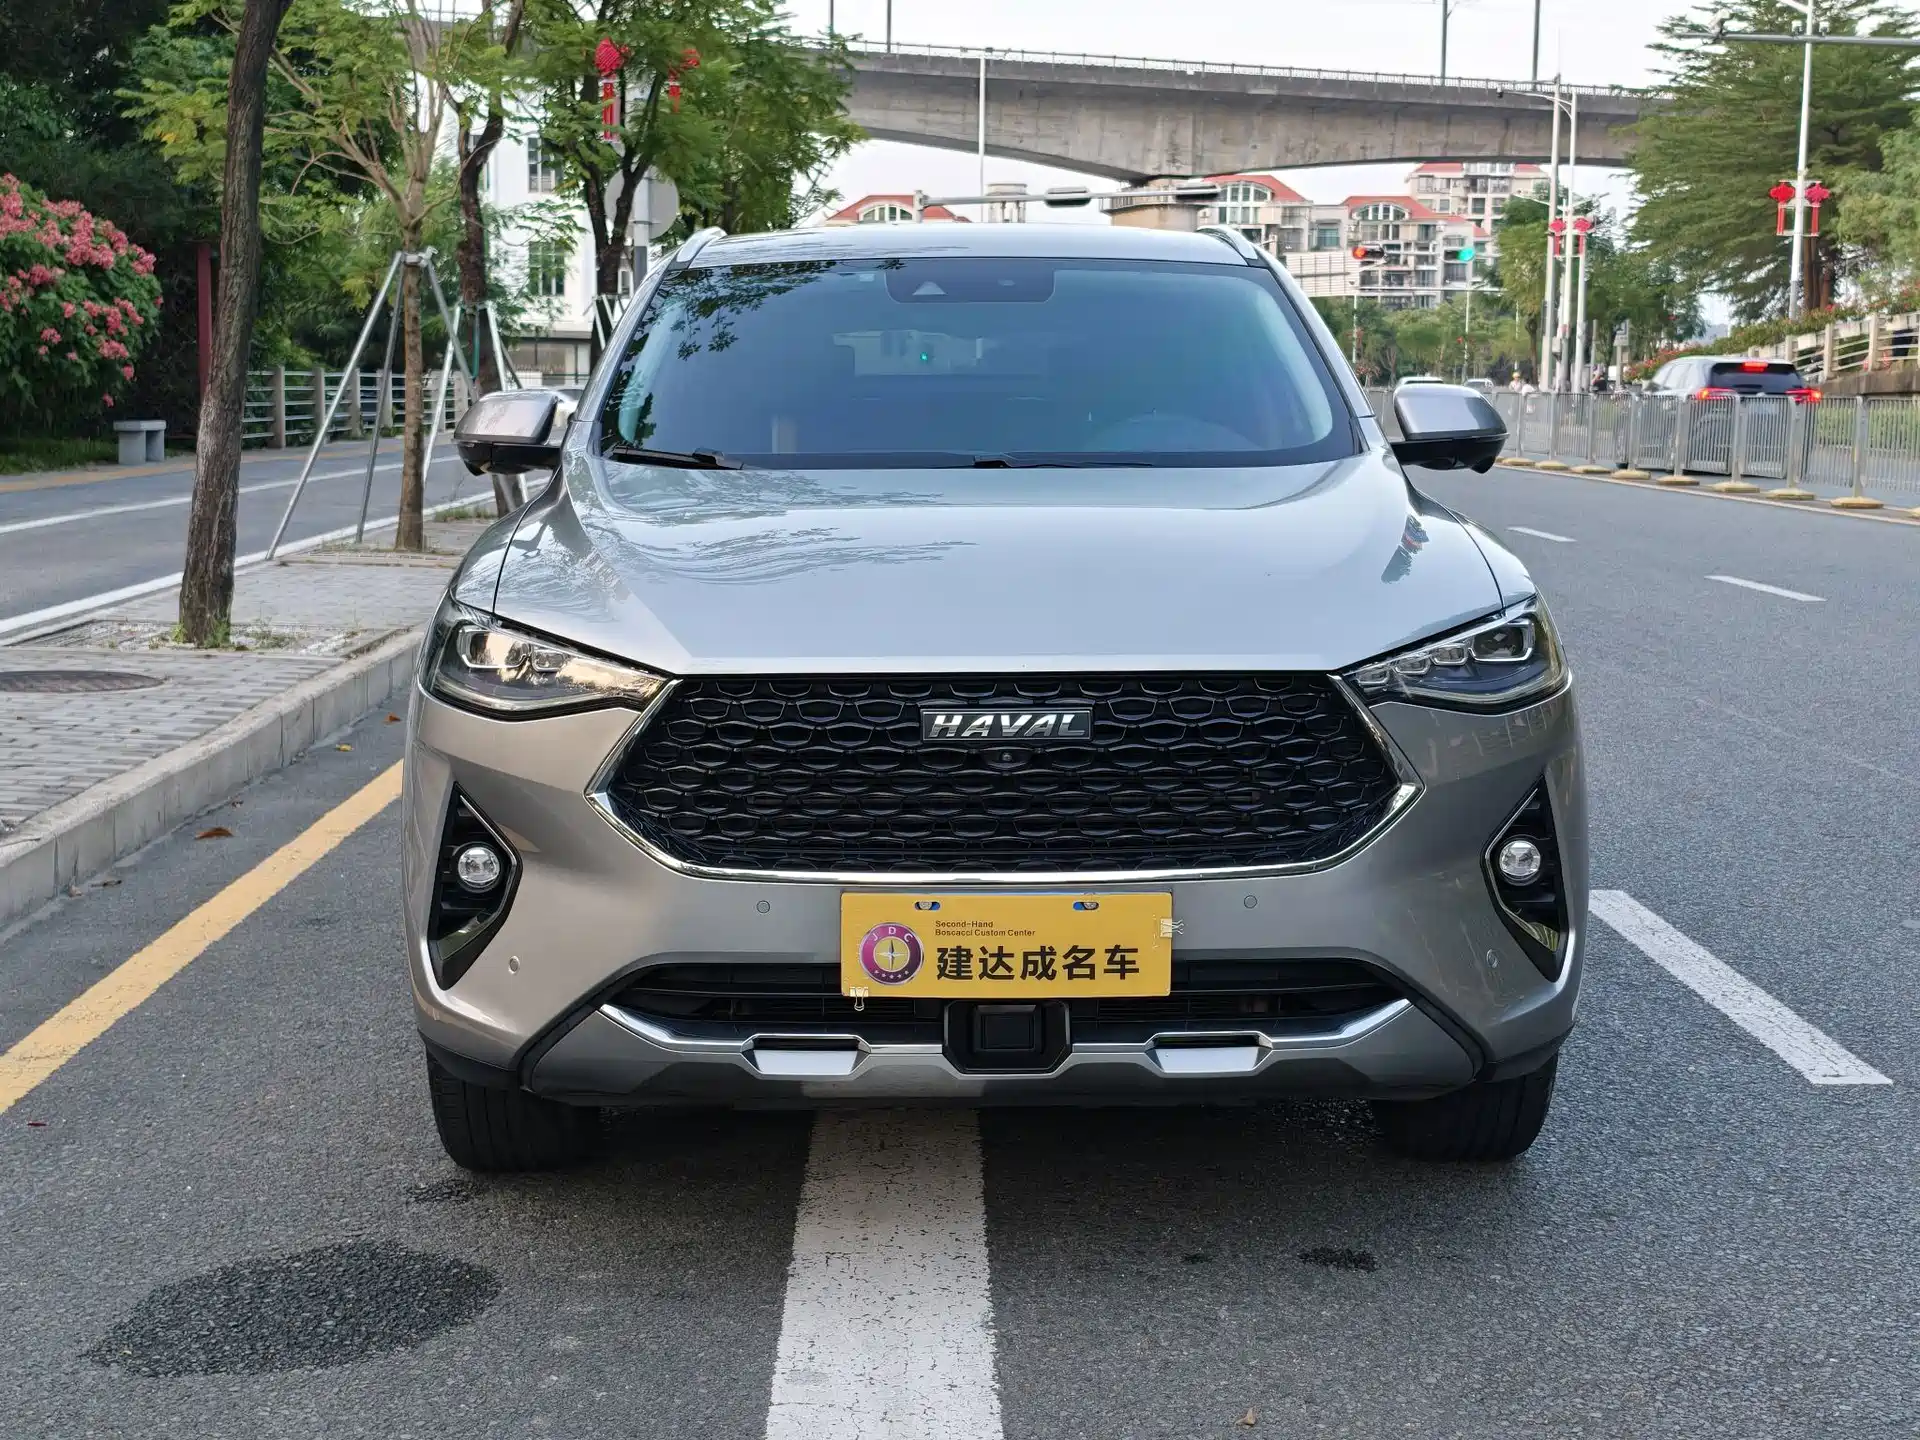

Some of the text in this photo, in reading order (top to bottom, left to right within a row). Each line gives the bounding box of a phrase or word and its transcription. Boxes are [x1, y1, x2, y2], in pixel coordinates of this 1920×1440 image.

[929, 714, 1086, 737] HAVAL
[935, 920, 994, 929] Second-Hand
[974, 929, 1007, 937] Custom
[1008, 929, 1036, 937] Center
[936, 944, 1140, 981] 建达成名车
